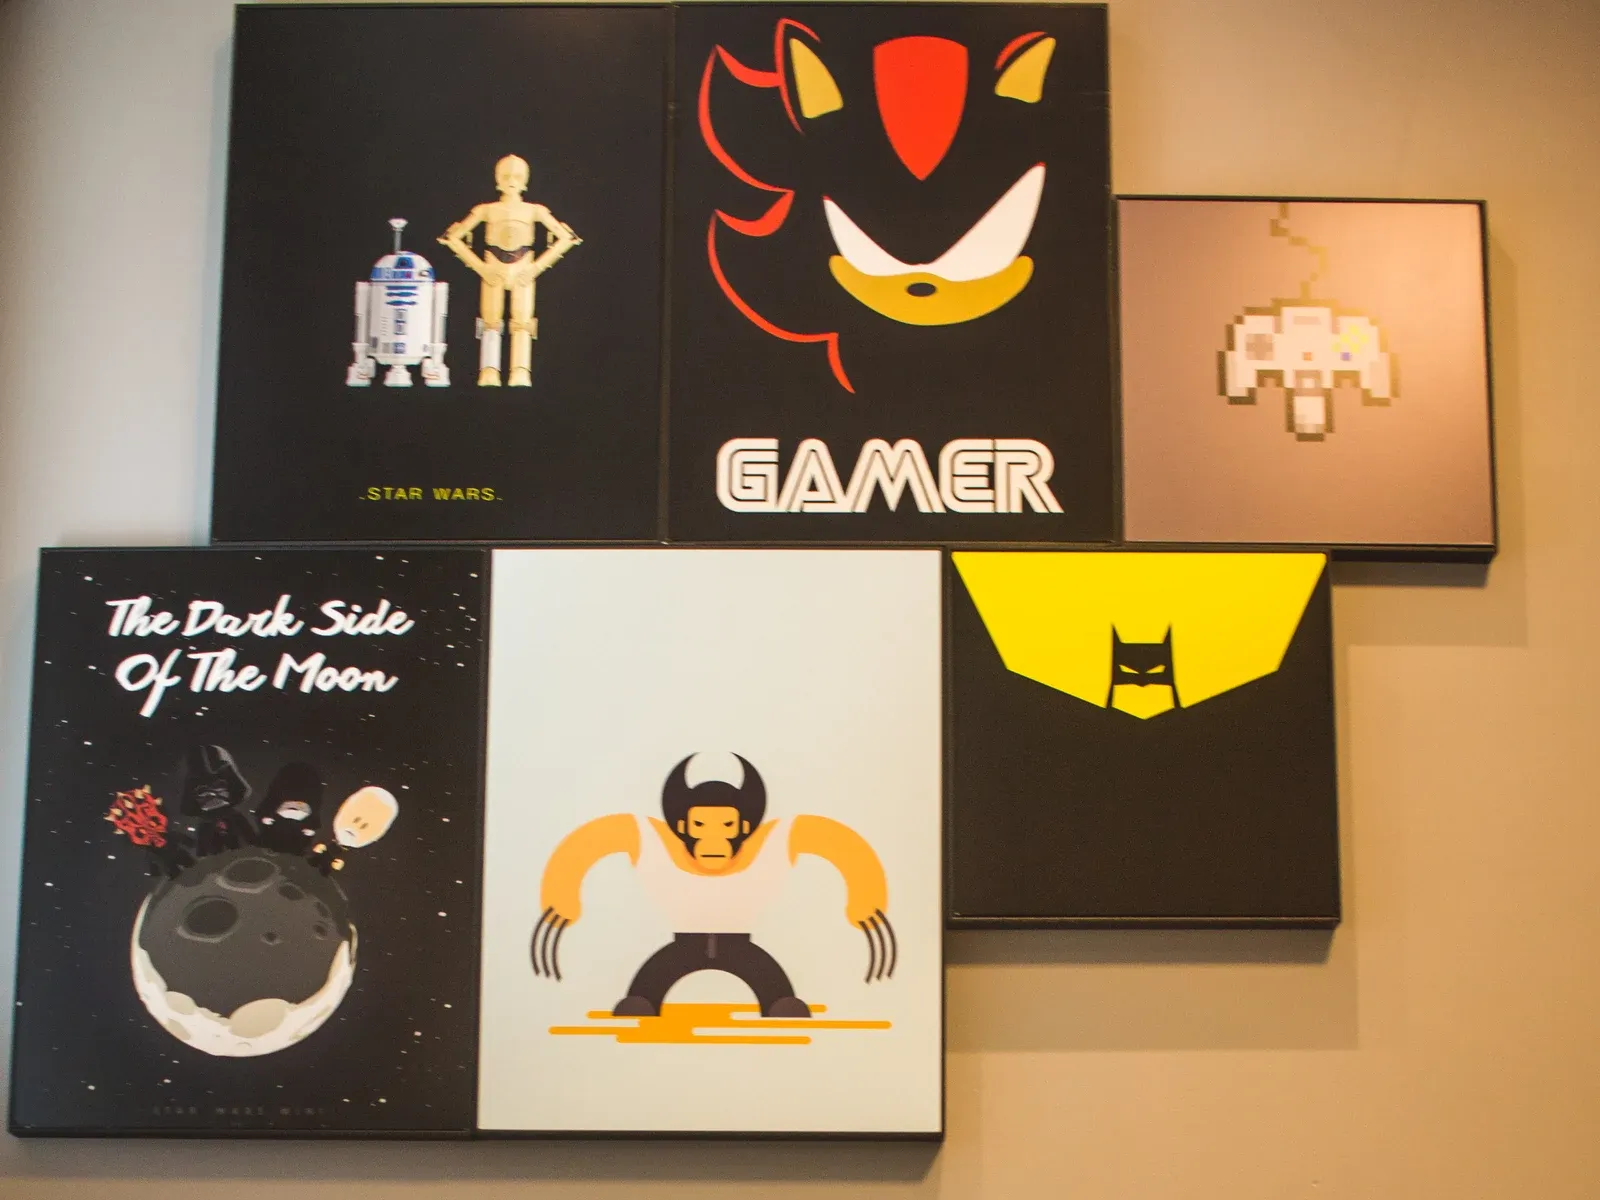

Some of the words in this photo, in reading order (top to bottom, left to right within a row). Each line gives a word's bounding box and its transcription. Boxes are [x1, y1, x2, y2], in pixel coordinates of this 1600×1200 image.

[716, 437, 1064, 514] GAMER
[105, 595, 180, 637] The
[181, 594, 305, 638] Dark
[311, 598, 415, 636] Side
[115, 648, 182, 718] Of
[187, 647, 267, 693] The
[272, 652, 399, 694] Moon
